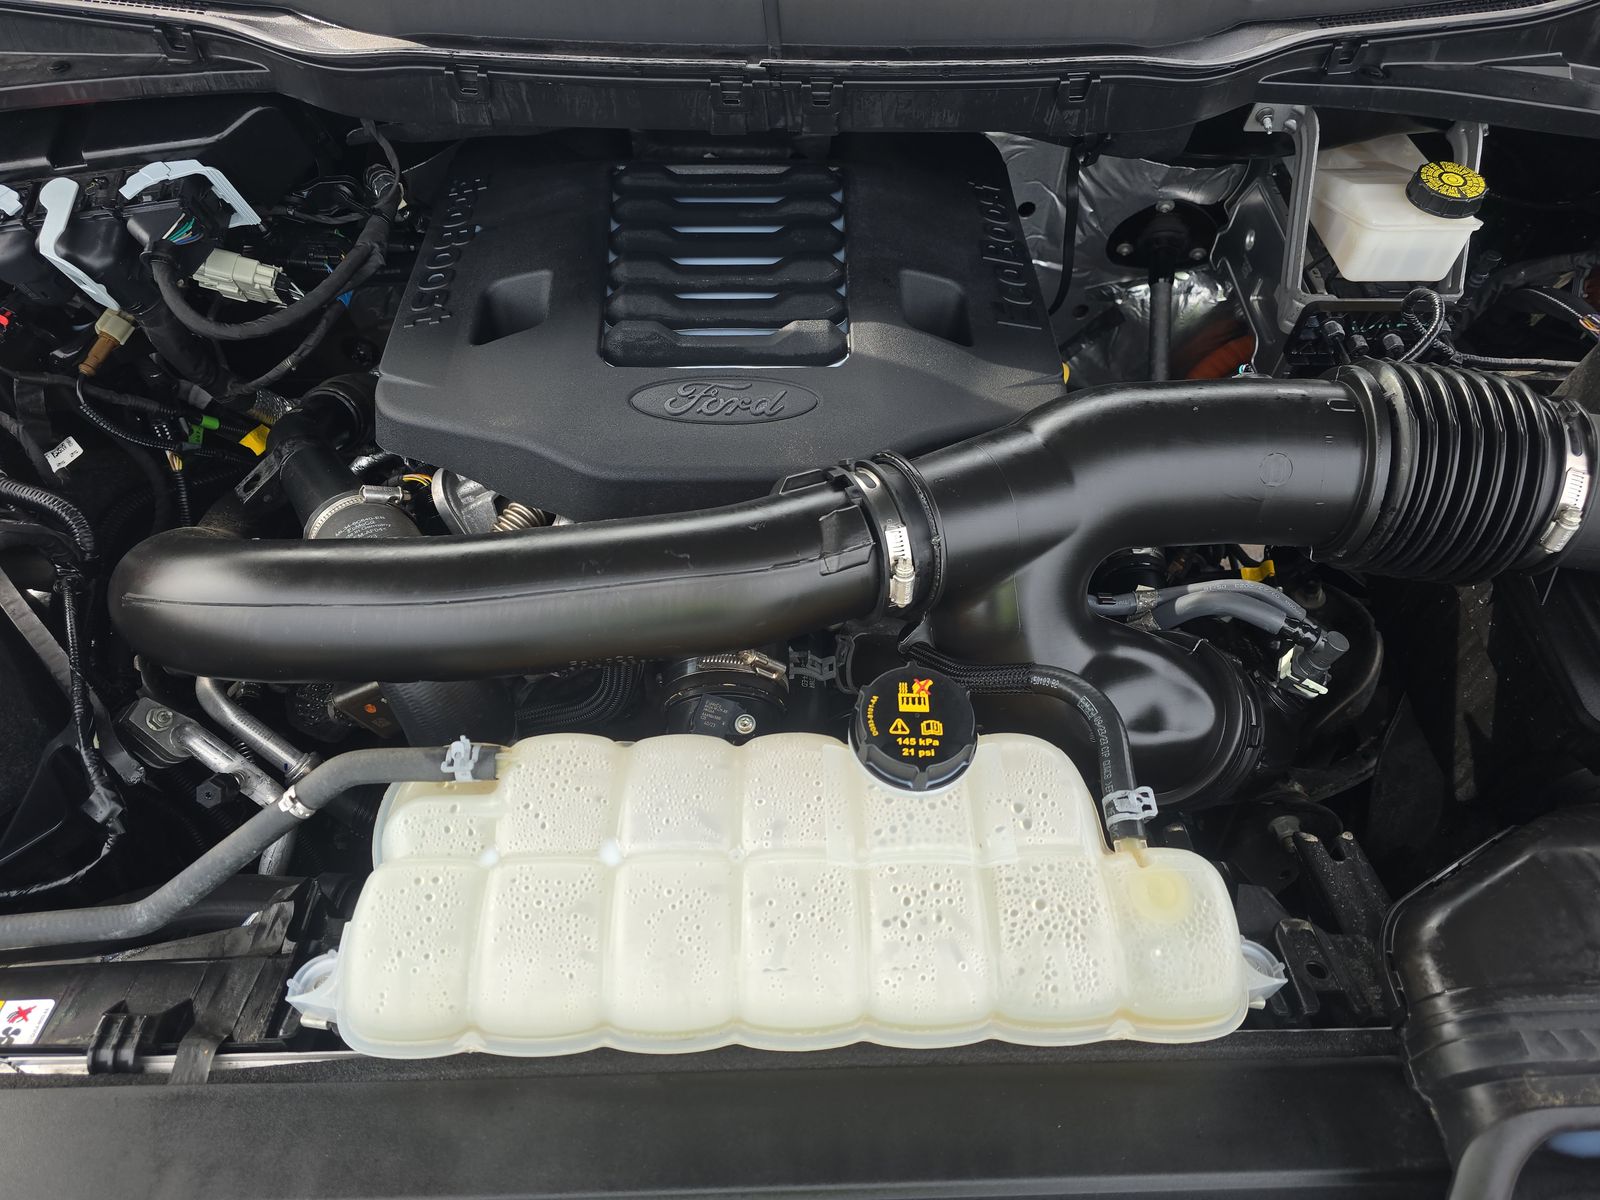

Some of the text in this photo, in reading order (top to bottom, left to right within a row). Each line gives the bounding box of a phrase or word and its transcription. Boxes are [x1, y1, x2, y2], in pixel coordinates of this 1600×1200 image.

[663, 381, 788, 417] Ford
[896, 737, 940, 746] 145 kPa
[902, 748, 935, 758] 21 psi
